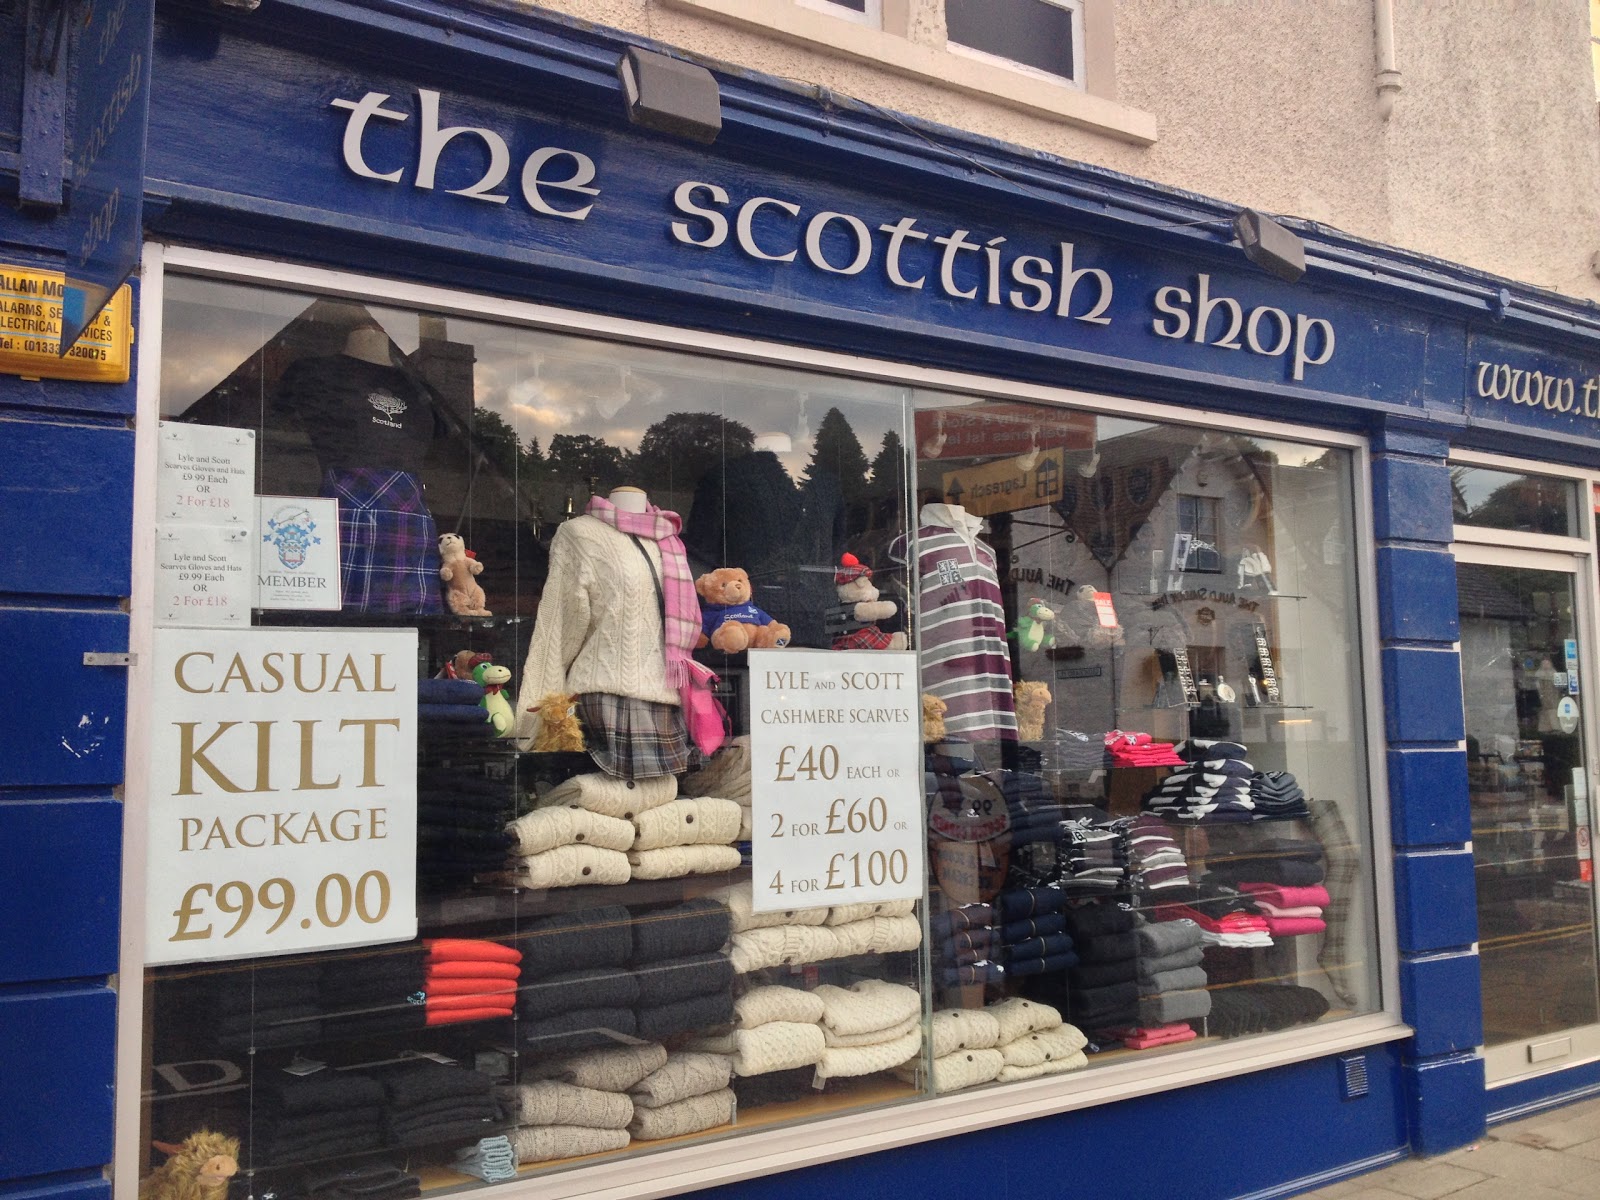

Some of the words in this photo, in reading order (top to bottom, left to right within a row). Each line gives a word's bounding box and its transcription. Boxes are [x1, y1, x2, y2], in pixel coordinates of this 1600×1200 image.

[330, 88, 601, 220] the
[671, 181, 1113, 325] scottish
[1153, 274, 1336, 380] shop
[0, 274, 37, 294] ALLAN
[80, 328, 113, 342] VICES
[0, 336, 13, 350] Tel
[372, 416, 402, 429] Scotland
[178, 453, 195, 463] Lyle
[196, 456, 210, 464] and
[211, 456, 231, 466] Scott
[165, 462, 191, 471] Scarves
[191, 464, 216, 474] Gloves
[216, 466, 229, 474] and
[230, 467, 246, 476] Hats
[182, 473, 206, 482] £9.99
[207, 475, 228, 484] Each
[196, 485, 211, 494] OR
[176, 494, 184, 506] 2
[187, 495, 207, 507] For
[209, 497, 231, 509] £18
[174, 553, 191, 563] Lyle
[192, 554, 206, 562] and
[208, 554, 227, 562] Scott
[160, 562, 187, 571] Scarves
[188, 563, 212, 572] Gloves
[213, 564, 226, 572] and
[227, 564, 243, 572] Hats
[178, 572, 203, 582] £9.99
[204, 573, 225, 583] Each
[256, 575, 328, 589] MEMBER
[192, 583, 208, 592] OR
[172, 595, 180, 607] 2
[184, 595, 204, 607] For
[206, 595, 228, 607] £18
[174, 651, 397, 694] CASUAL
[765, 671, 810, 690] LYLE
[814, 681, 836, 690] AND
[841, 672, 905, 690] SCOTT
[760, 709, 845, 725] CASHMERE
[849, 708, 910, 724] SCARVES
[171, 718, 401, 796] KILT
[773, 744, 840, 782] £40
[846, 766, 881, 780] EACH
[886, 768, 900, 778] OR
[770, 813, 785, 838] 2
[791, 824, 821, 837] FOR
[823, 796, 888, 836] £60
[893, 821, 908, 831] OR
[178, 807, 388, 852] PACKAGE
[768, 869, 784, 894] 4
[790, 879, 820, 893] FOR
[823, 848, 908, 891] £100
[167, 869, 392, 943] £99.00
